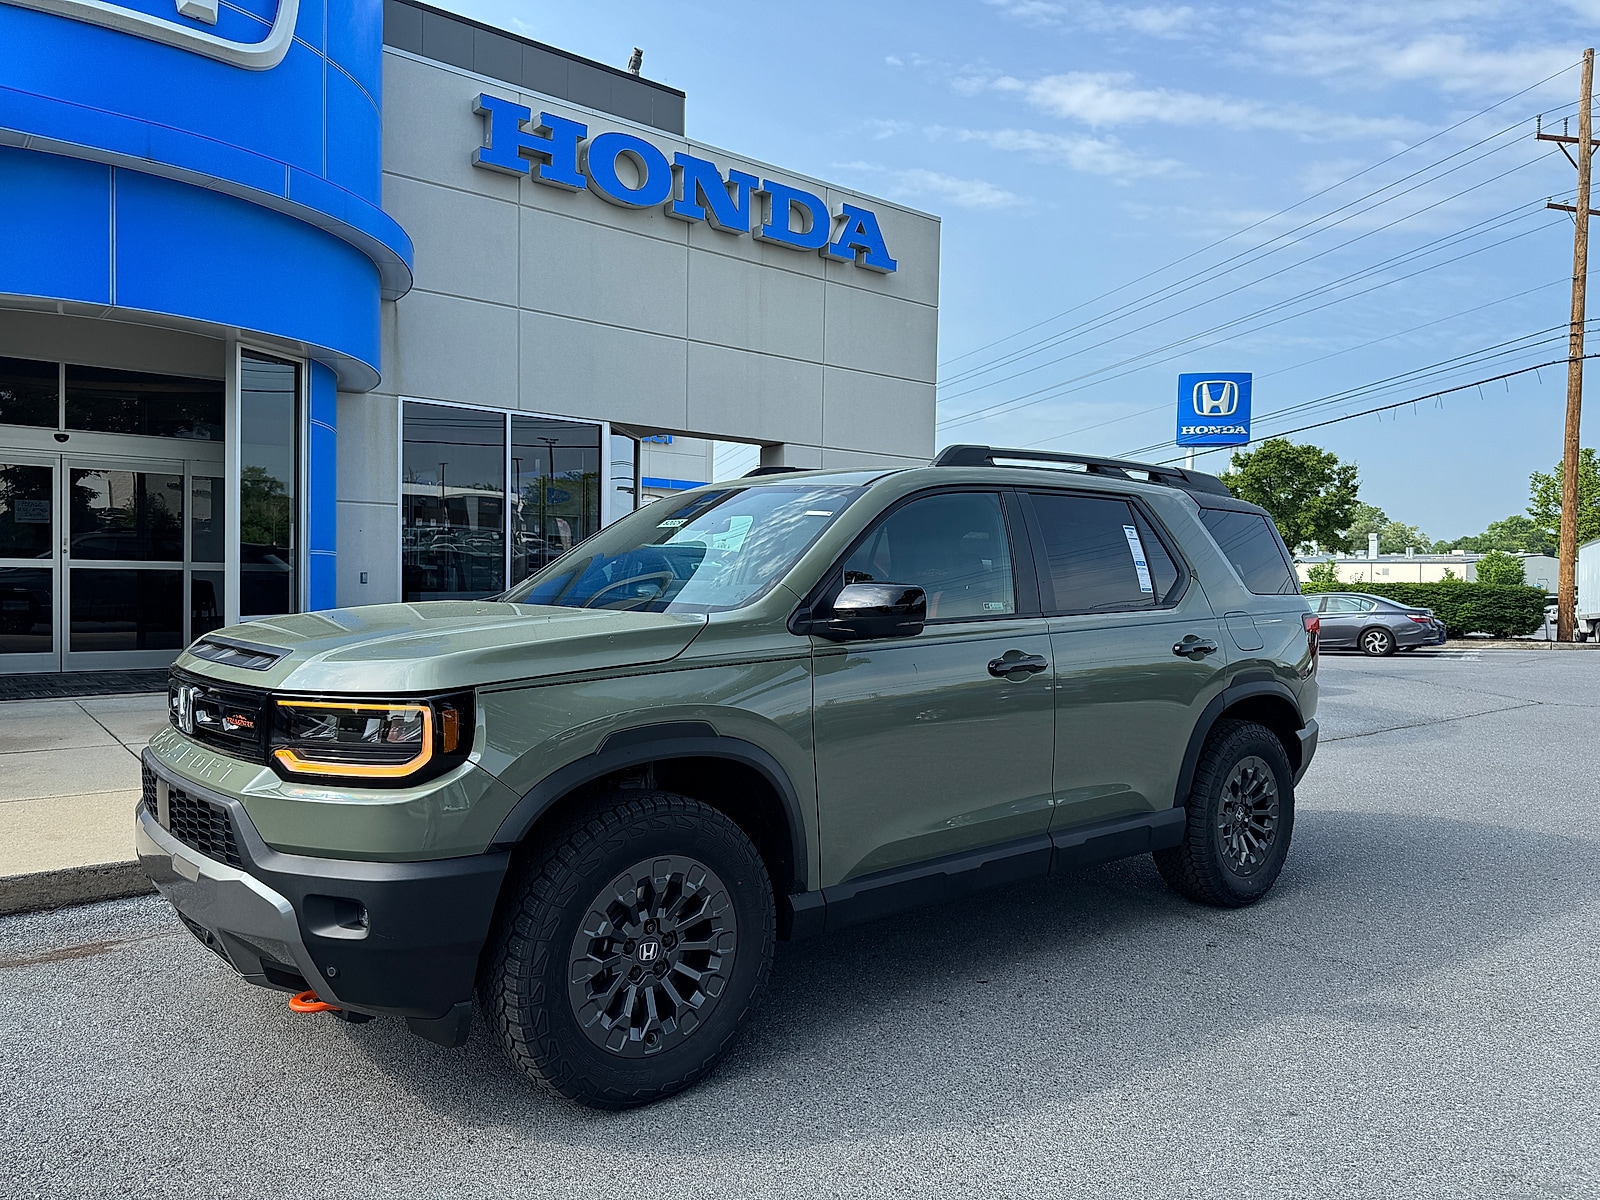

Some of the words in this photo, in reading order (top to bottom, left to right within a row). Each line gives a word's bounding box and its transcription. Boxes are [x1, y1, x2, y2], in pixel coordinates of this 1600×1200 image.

[472, 93, 898, 274] HONDA
[1181, 426, 1248, 435] HONDA
[151, 727, 244, 783] PASSPORT
